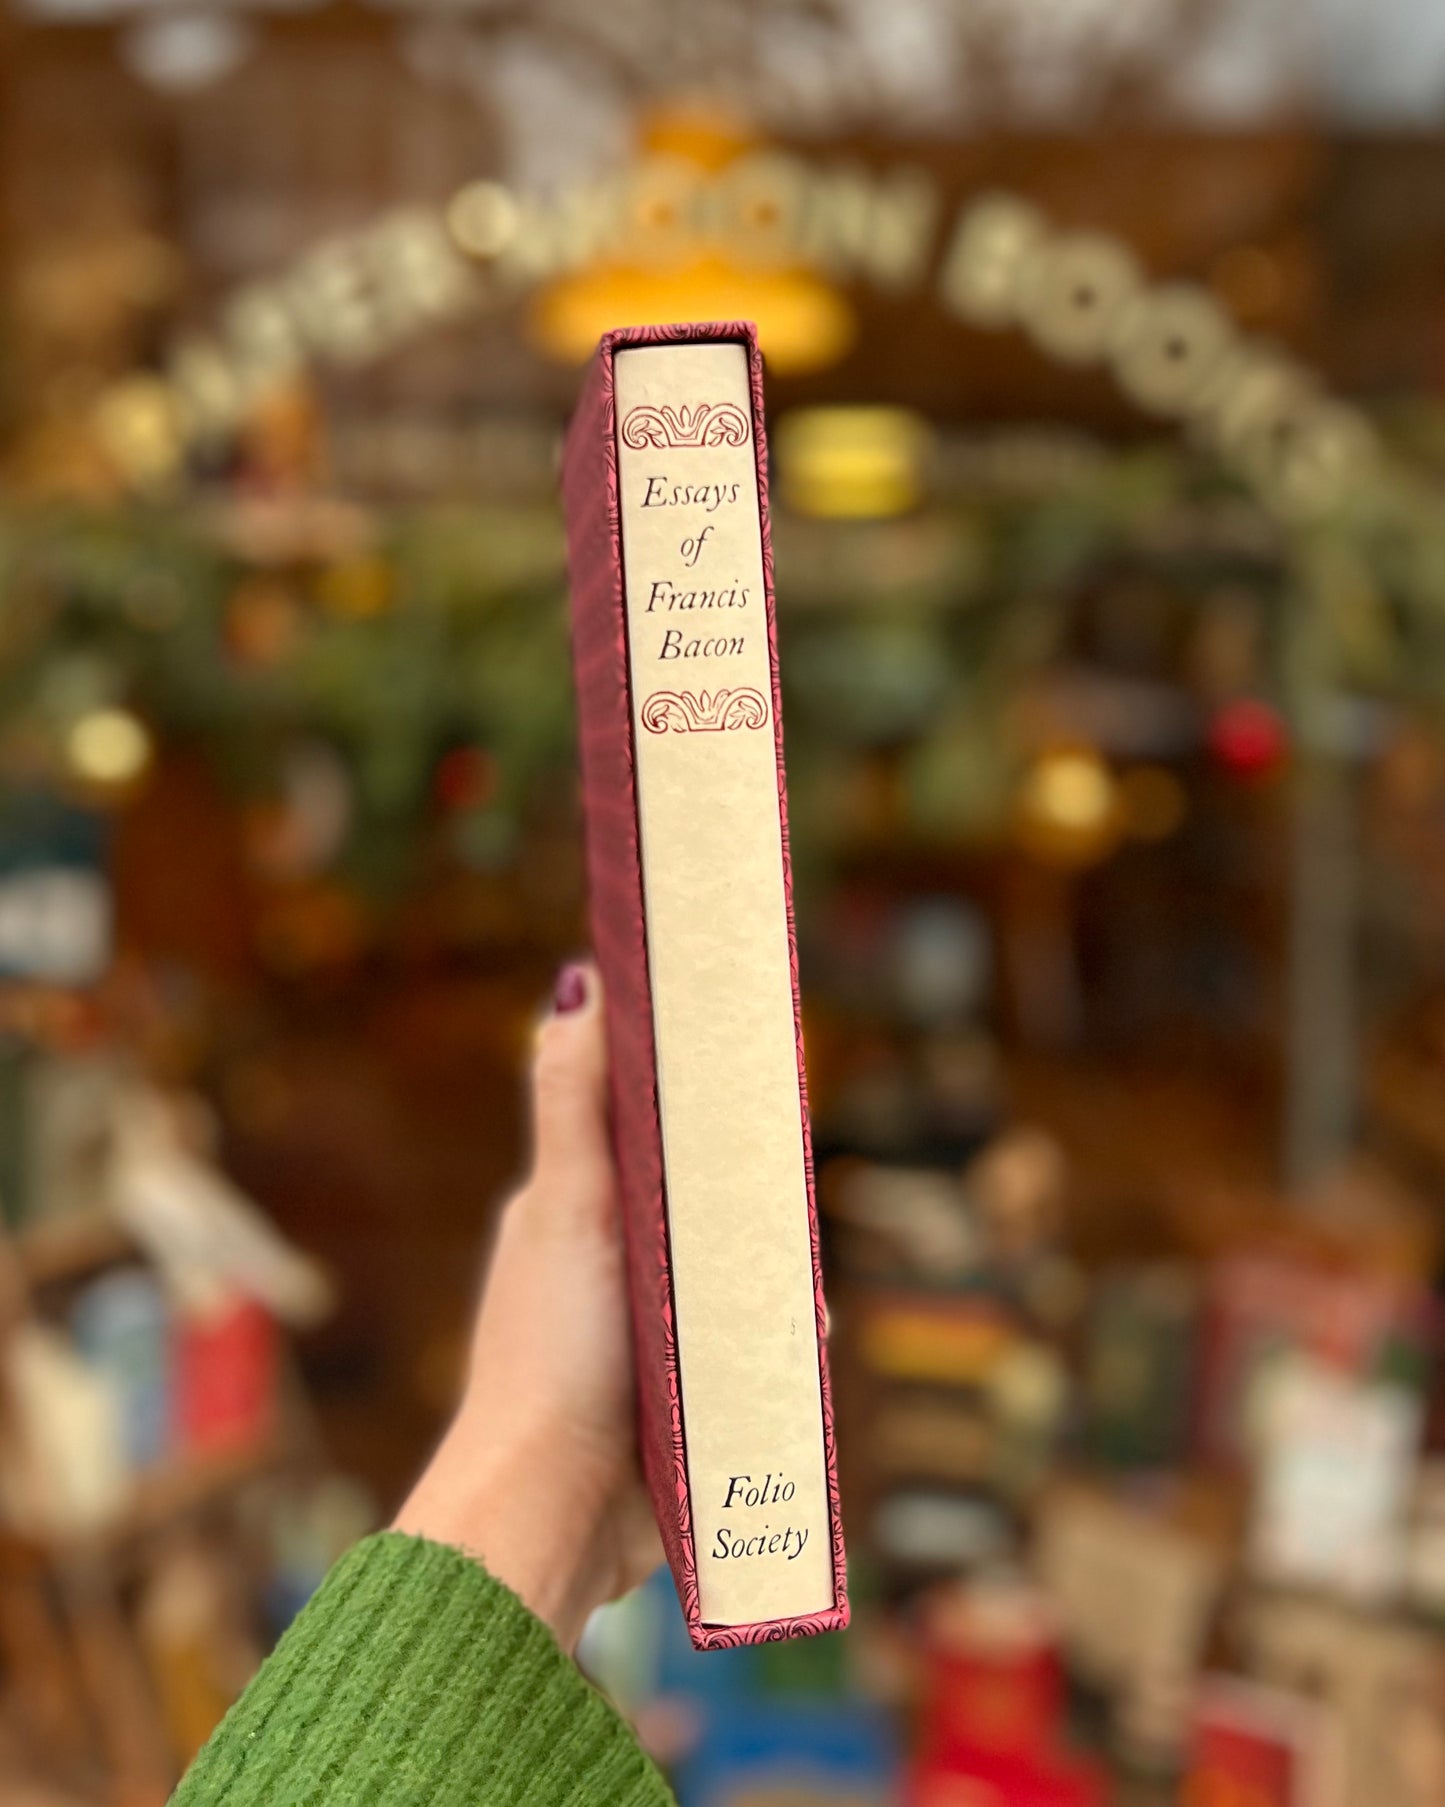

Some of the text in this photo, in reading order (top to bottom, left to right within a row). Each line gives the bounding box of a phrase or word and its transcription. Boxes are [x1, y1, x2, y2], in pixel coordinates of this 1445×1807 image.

[641, 476, 741, 511] Essays
[680, 526, 715, 567] of
[646, 579, 750, 613] Francis
[659, 629, 746, 661] Bacon
[723, 1472, 796, 1508] Folio
[712, 1525, 809, 1560] Society
